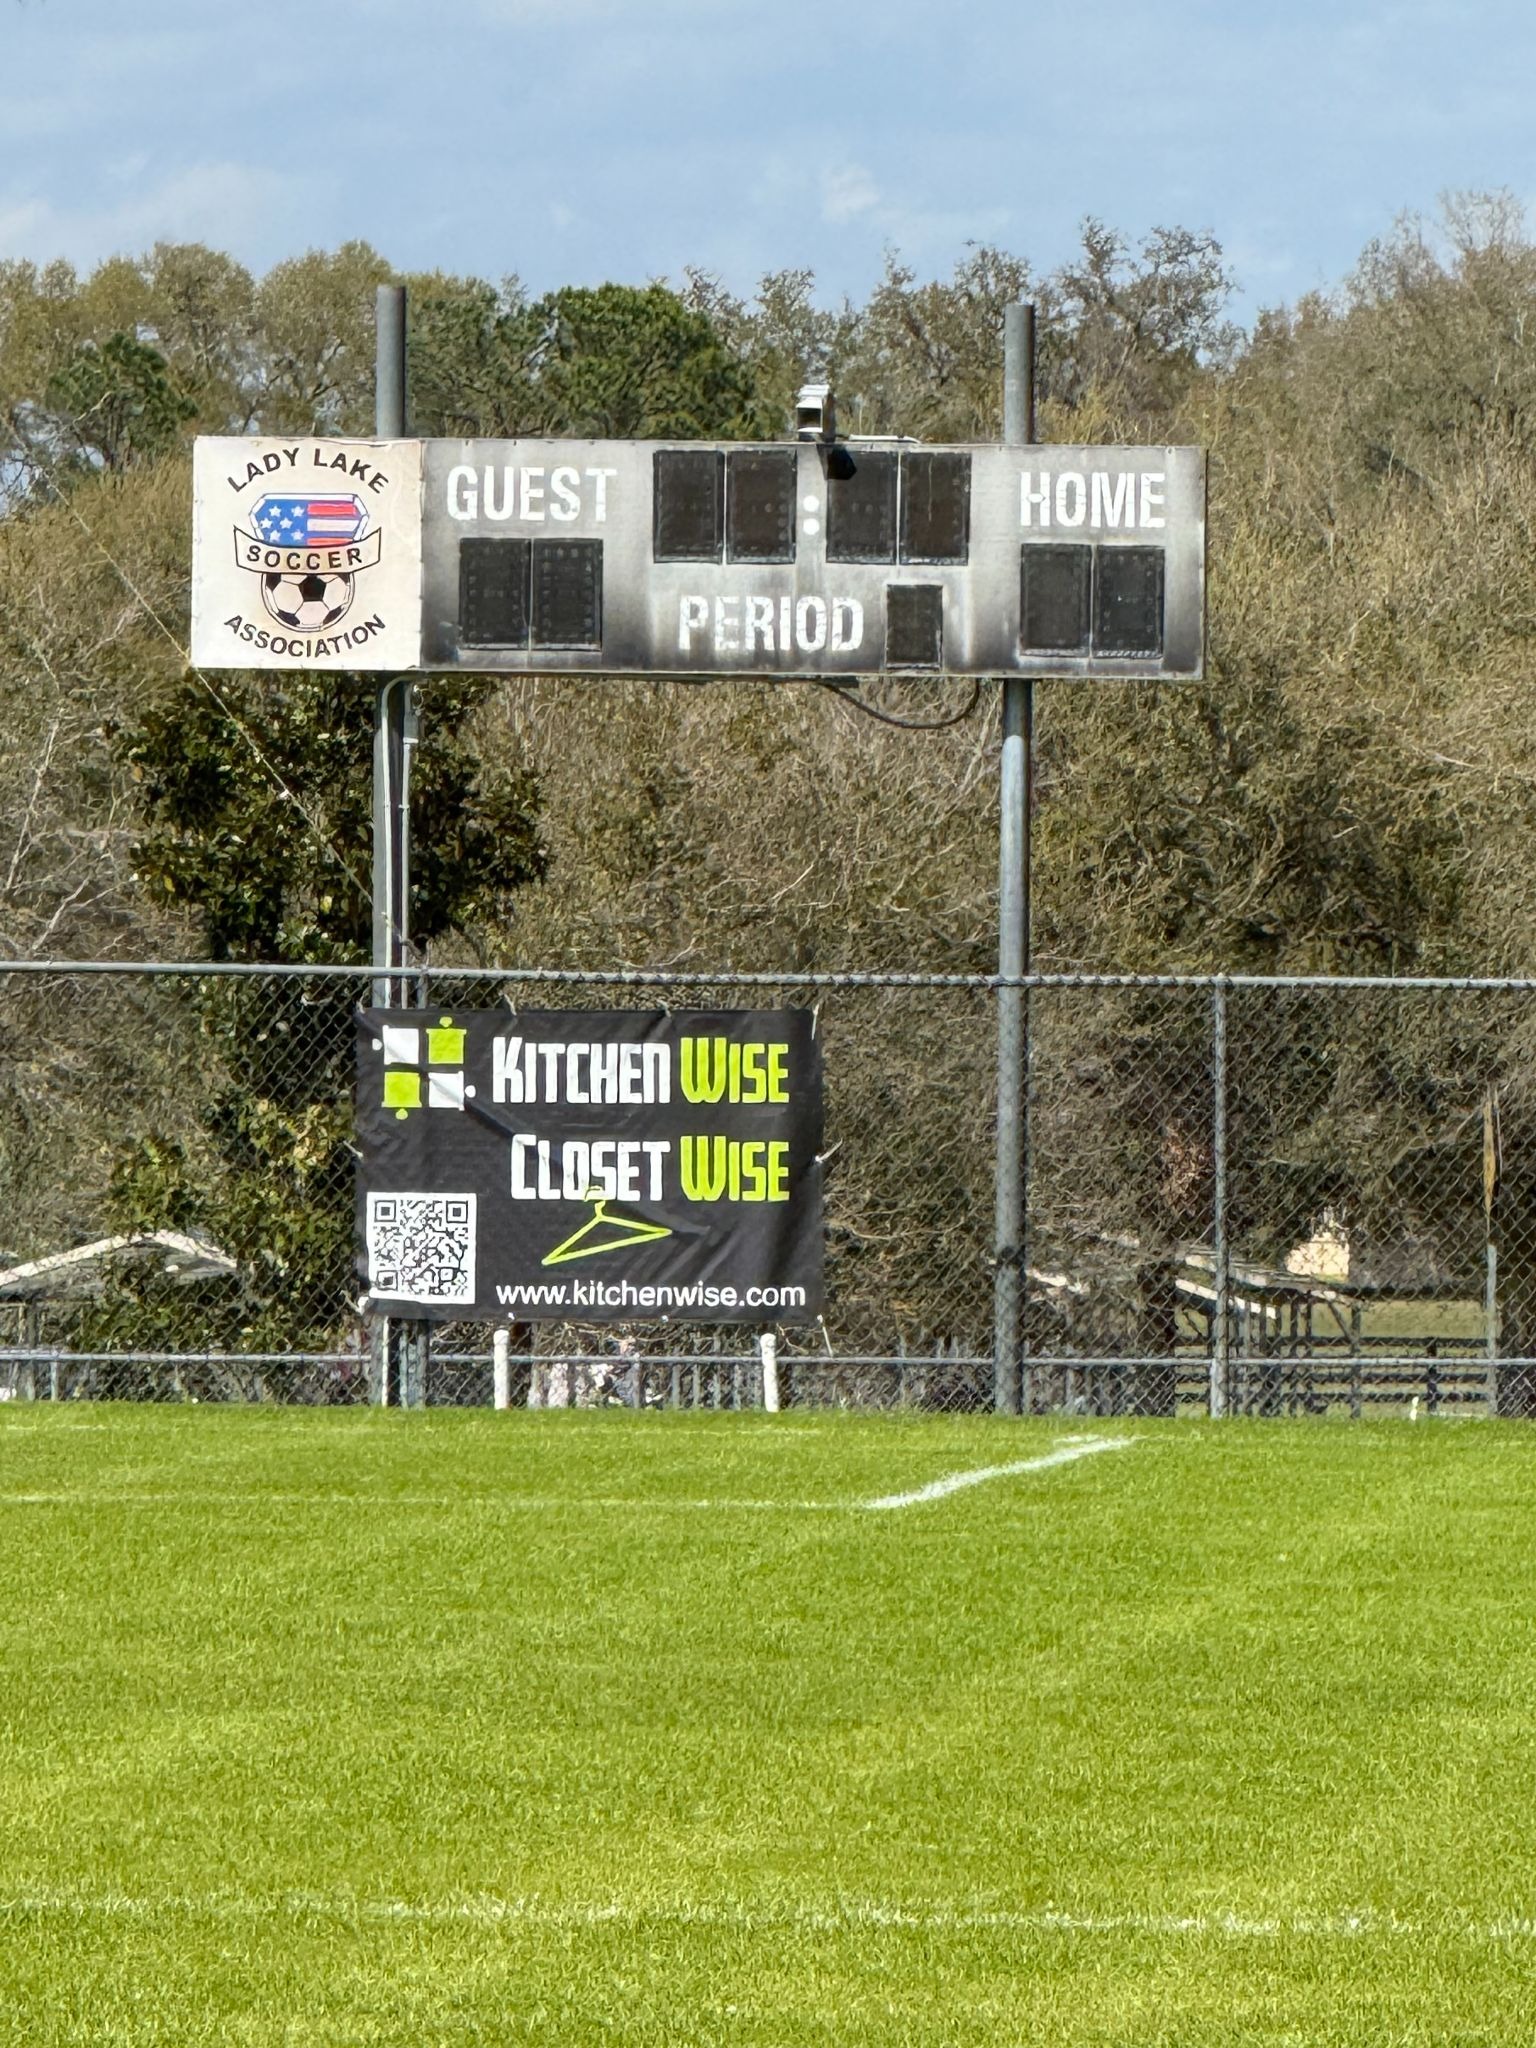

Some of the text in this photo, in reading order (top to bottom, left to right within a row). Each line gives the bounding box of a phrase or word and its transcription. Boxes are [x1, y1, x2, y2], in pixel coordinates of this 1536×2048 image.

[227, 447, 389, 494] LADY LAKE
[447, 465, 617, 522] GUEST
[1020, 472, 1166, 528] HOME
[246, 545, 363, 571] SOCCER
[224, 614, 386, 658] ASSOCIATION
[678, 596, 864, 652] PERIOD
[492, 1036, 790, 1104] KITCHEN WISE
[511, 1134, 790, 1202] CLOSET WISE
[496, 1279, 806, 1307] www.kitchenwise.com
